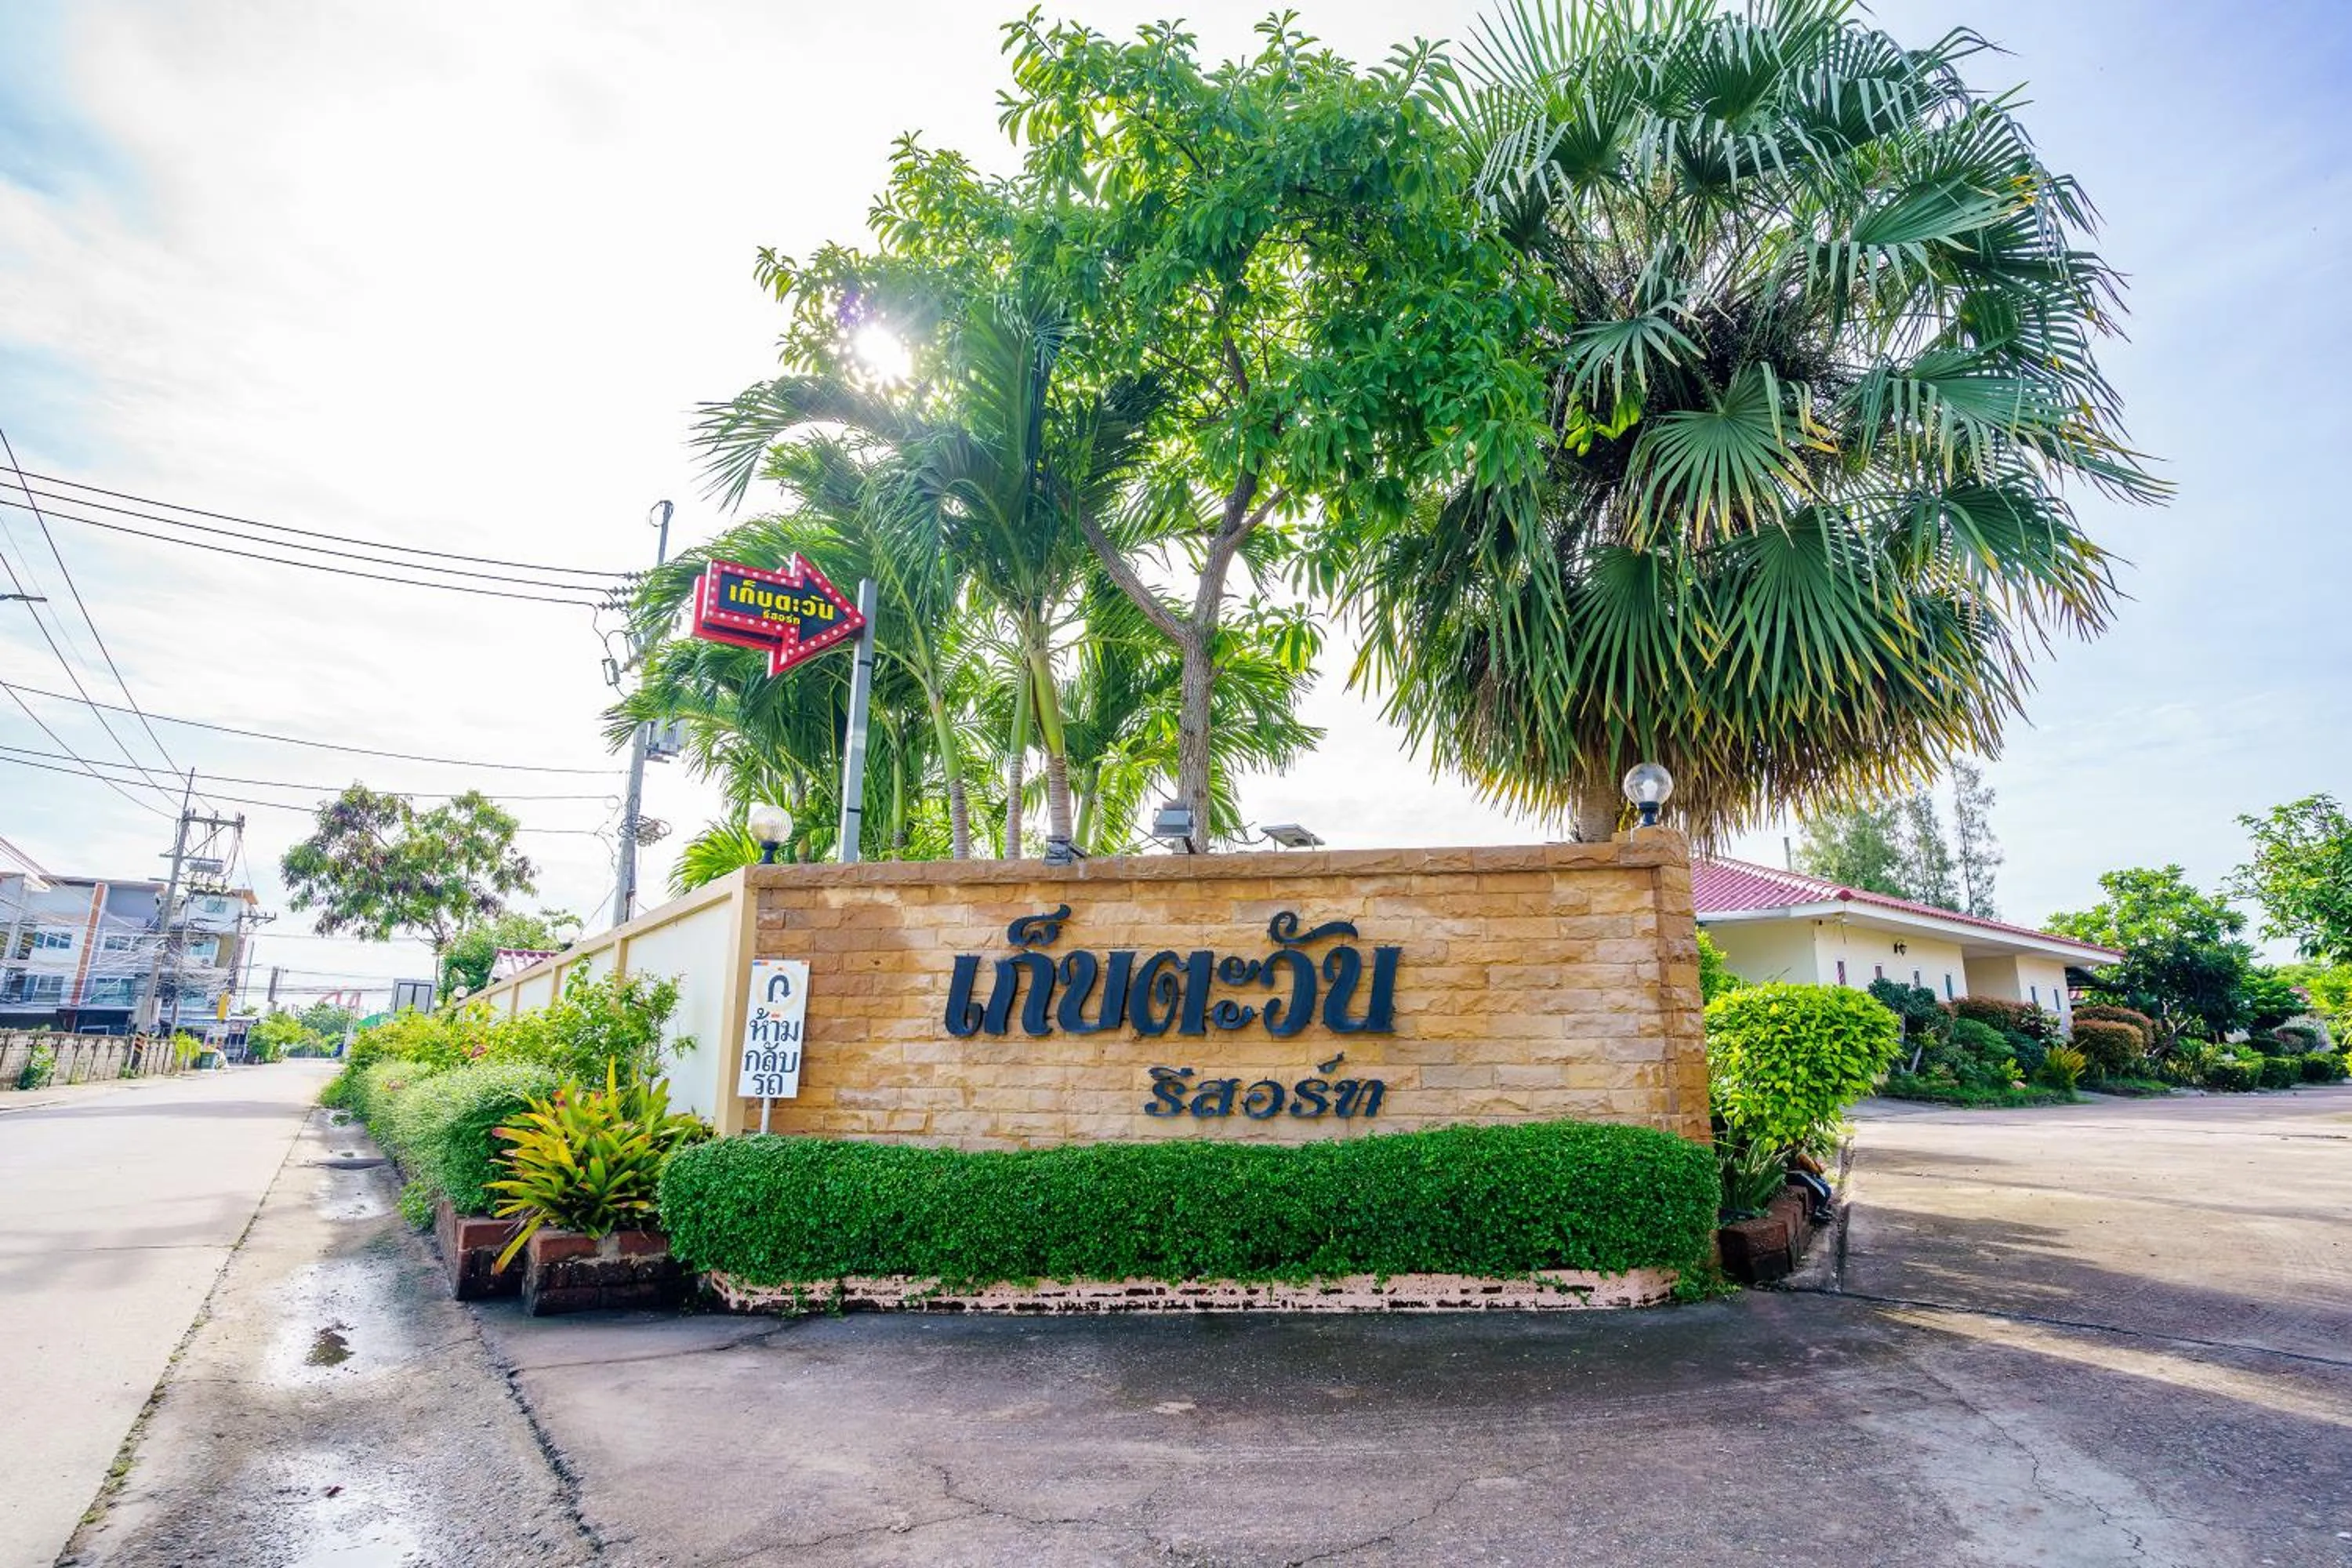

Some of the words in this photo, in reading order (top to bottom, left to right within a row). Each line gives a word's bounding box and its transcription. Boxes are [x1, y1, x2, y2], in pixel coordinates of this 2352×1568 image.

[729, 579, 835, 621] เก็บตะวัน
[946, 903, 1403, 1038] เก็บตะวัน
[750, 1007, 800, 1042] ห้าม
[744, 1041, 798, 1073] กลับ
[753, 1073, 783, 1095] รถ
